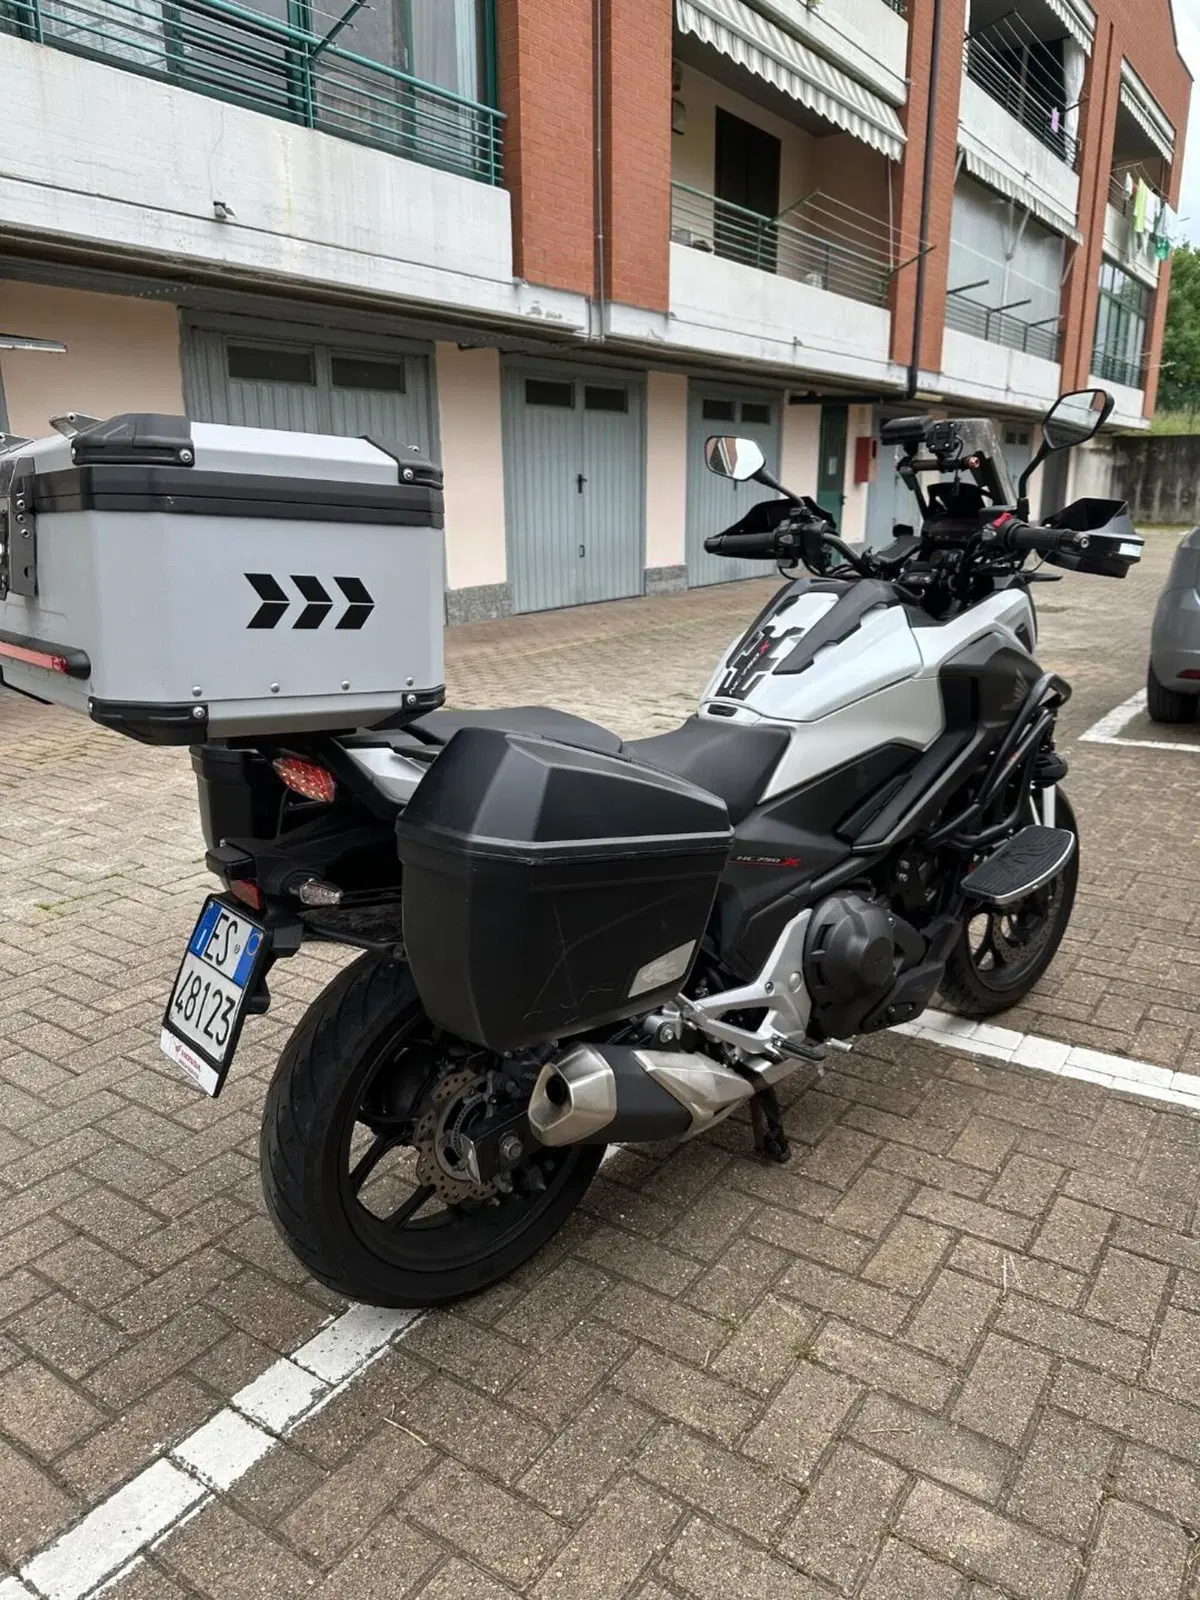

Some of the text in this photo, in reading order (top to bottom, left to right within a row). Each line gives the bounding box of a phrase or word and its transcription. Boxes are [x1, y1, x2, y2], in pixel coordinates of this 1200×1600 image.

[783, 855, 802, 867] X
[203, 912, 239, 966] ES
[174, 970, 236, 1046] 48123
